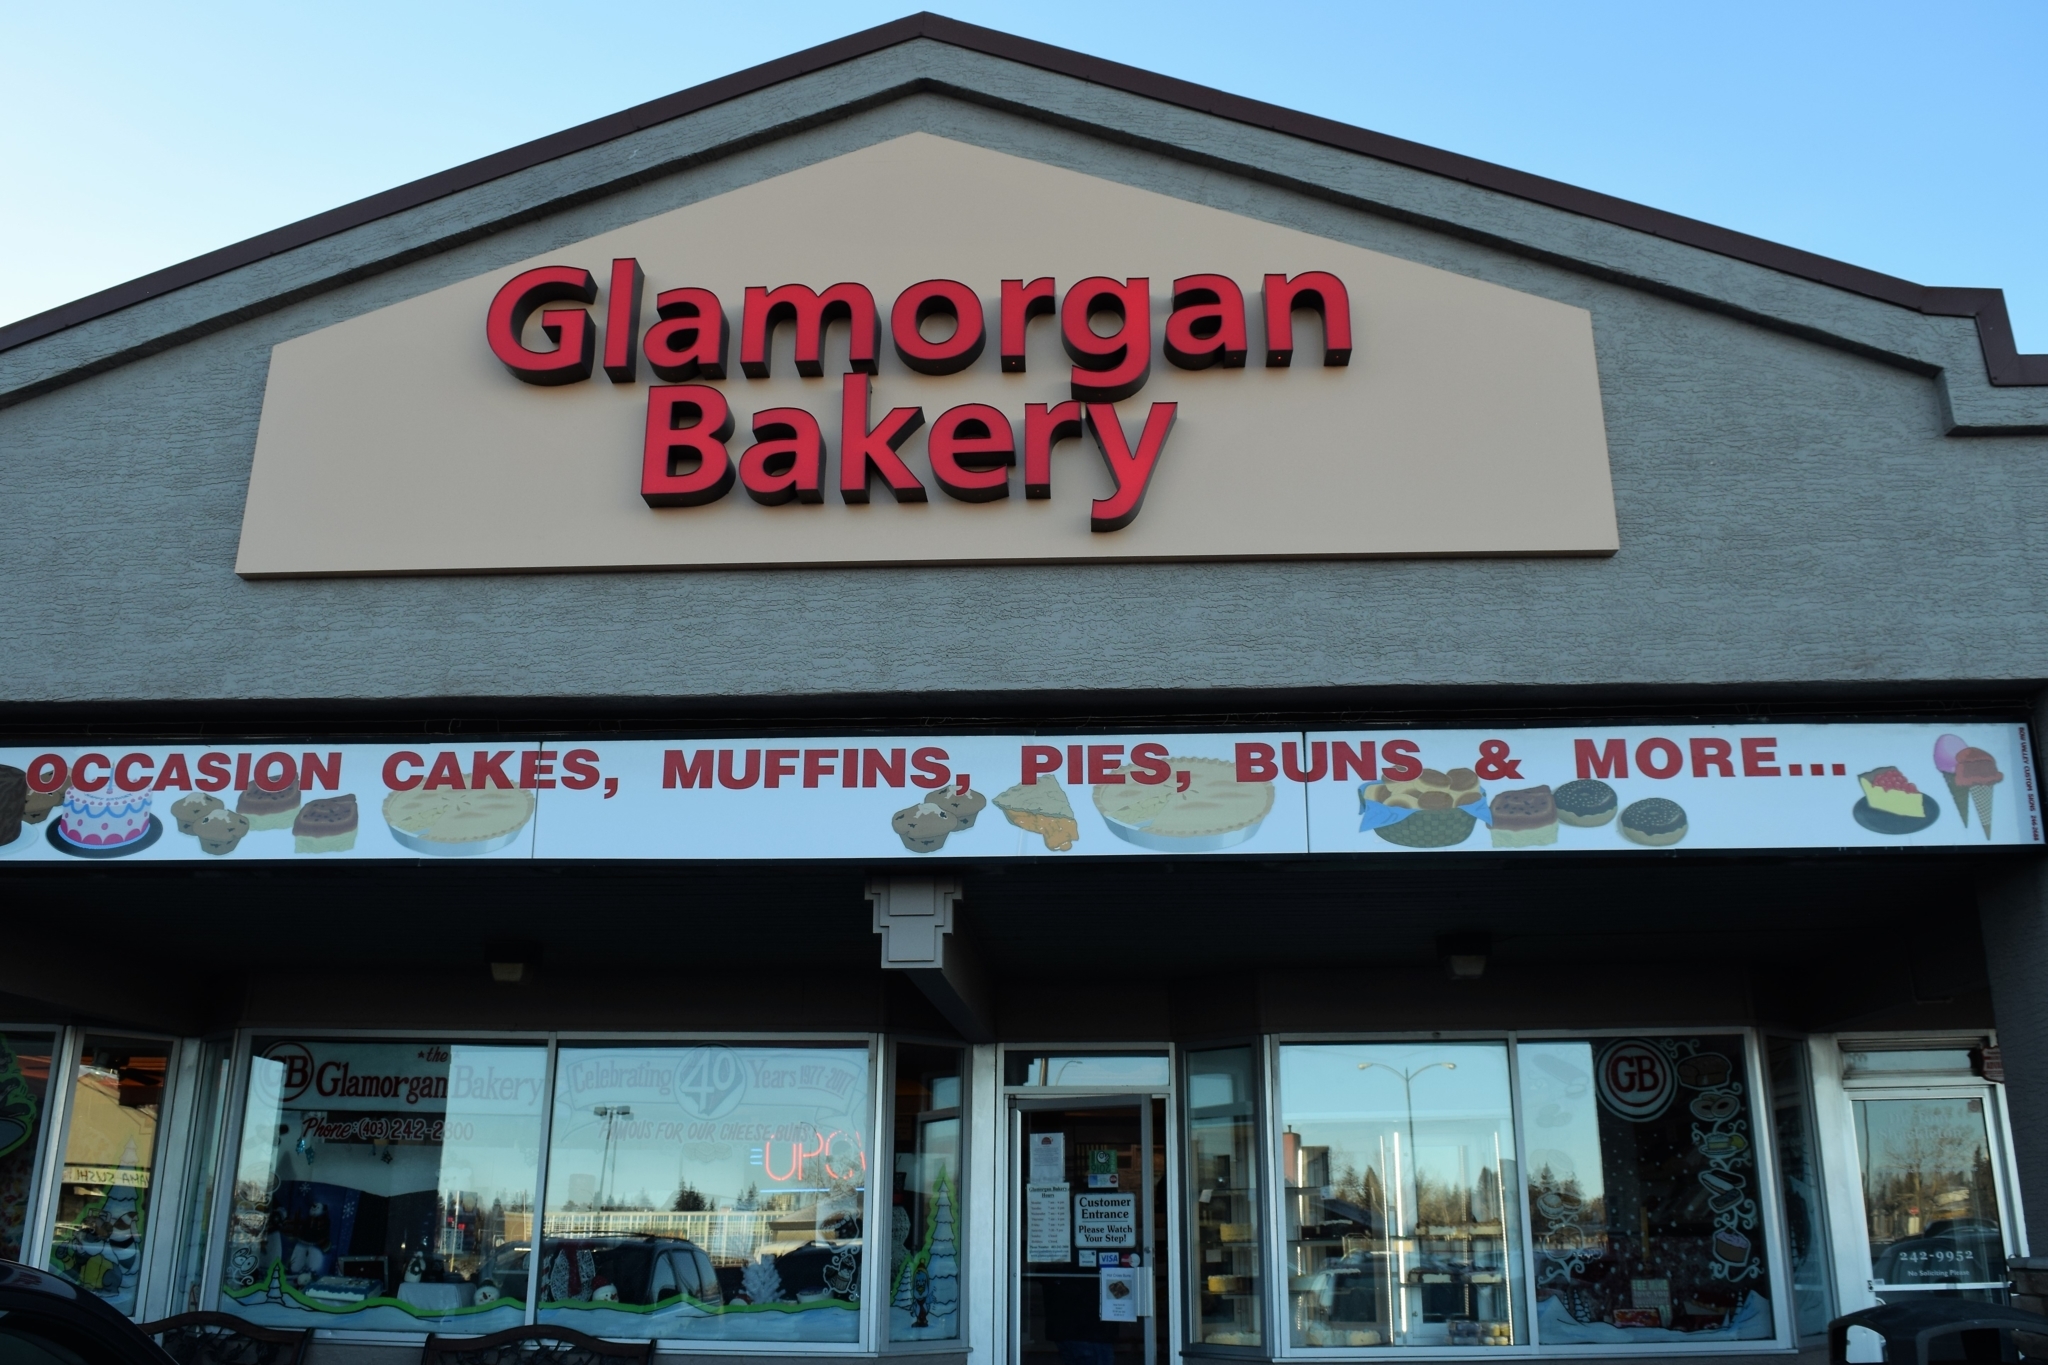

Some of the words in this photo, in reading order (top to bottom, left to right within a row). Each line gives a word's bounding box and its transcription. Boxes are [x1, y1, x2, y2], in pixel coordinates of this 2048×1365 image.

[486, 255, 1352, 402] Glamorgan
[641, 372, 1179, 532] Bakery
[25, 750, 343, 793] OCCASION
[381, 748, 620, 800] CAKES,
[662, 746, 972, 797] MUFFINS,
[1020, 742, 1192, 793] PIES,
[1234, 738, 1423, 783] BUNS
[1474, 738, 1526, 781] &
[1574, 736, 1847, 780] MORE...
[2024, 766, 2034, 791] CUSTOM
[2028, 793, 2037, 812] SIGNS
[426, 1046, 449, 1063] the
[315, 1061, 448, 1105] Glamorgan
[452, 1064, 545, 1106] Bakery
[572, 1059, 672, 1095] Celebrating
[747, 1058, 797, 1089] Years
[1612, 1055, 1660, 1093] GB
[655, 1121, 685, 1144] FOR
[687, 1121, 716, 1143] OUR
[719, 1121, 774, 1142] CHEESE
[1079, 1197, 1131, 1208] Customer
[1081, 1209, 1129, 1219] Entrance
[1078, 1225, 1105, 1234] Please
[1107, 1225, 1132, 1234] Watch
[1085, 1234, 1104, 1243] Your
[1106, 1234, 1127, 1244] Step!
[1101, 1254, 1118, 1263] VISA
[1898, 1249, 1974, 1263] 242-9952
